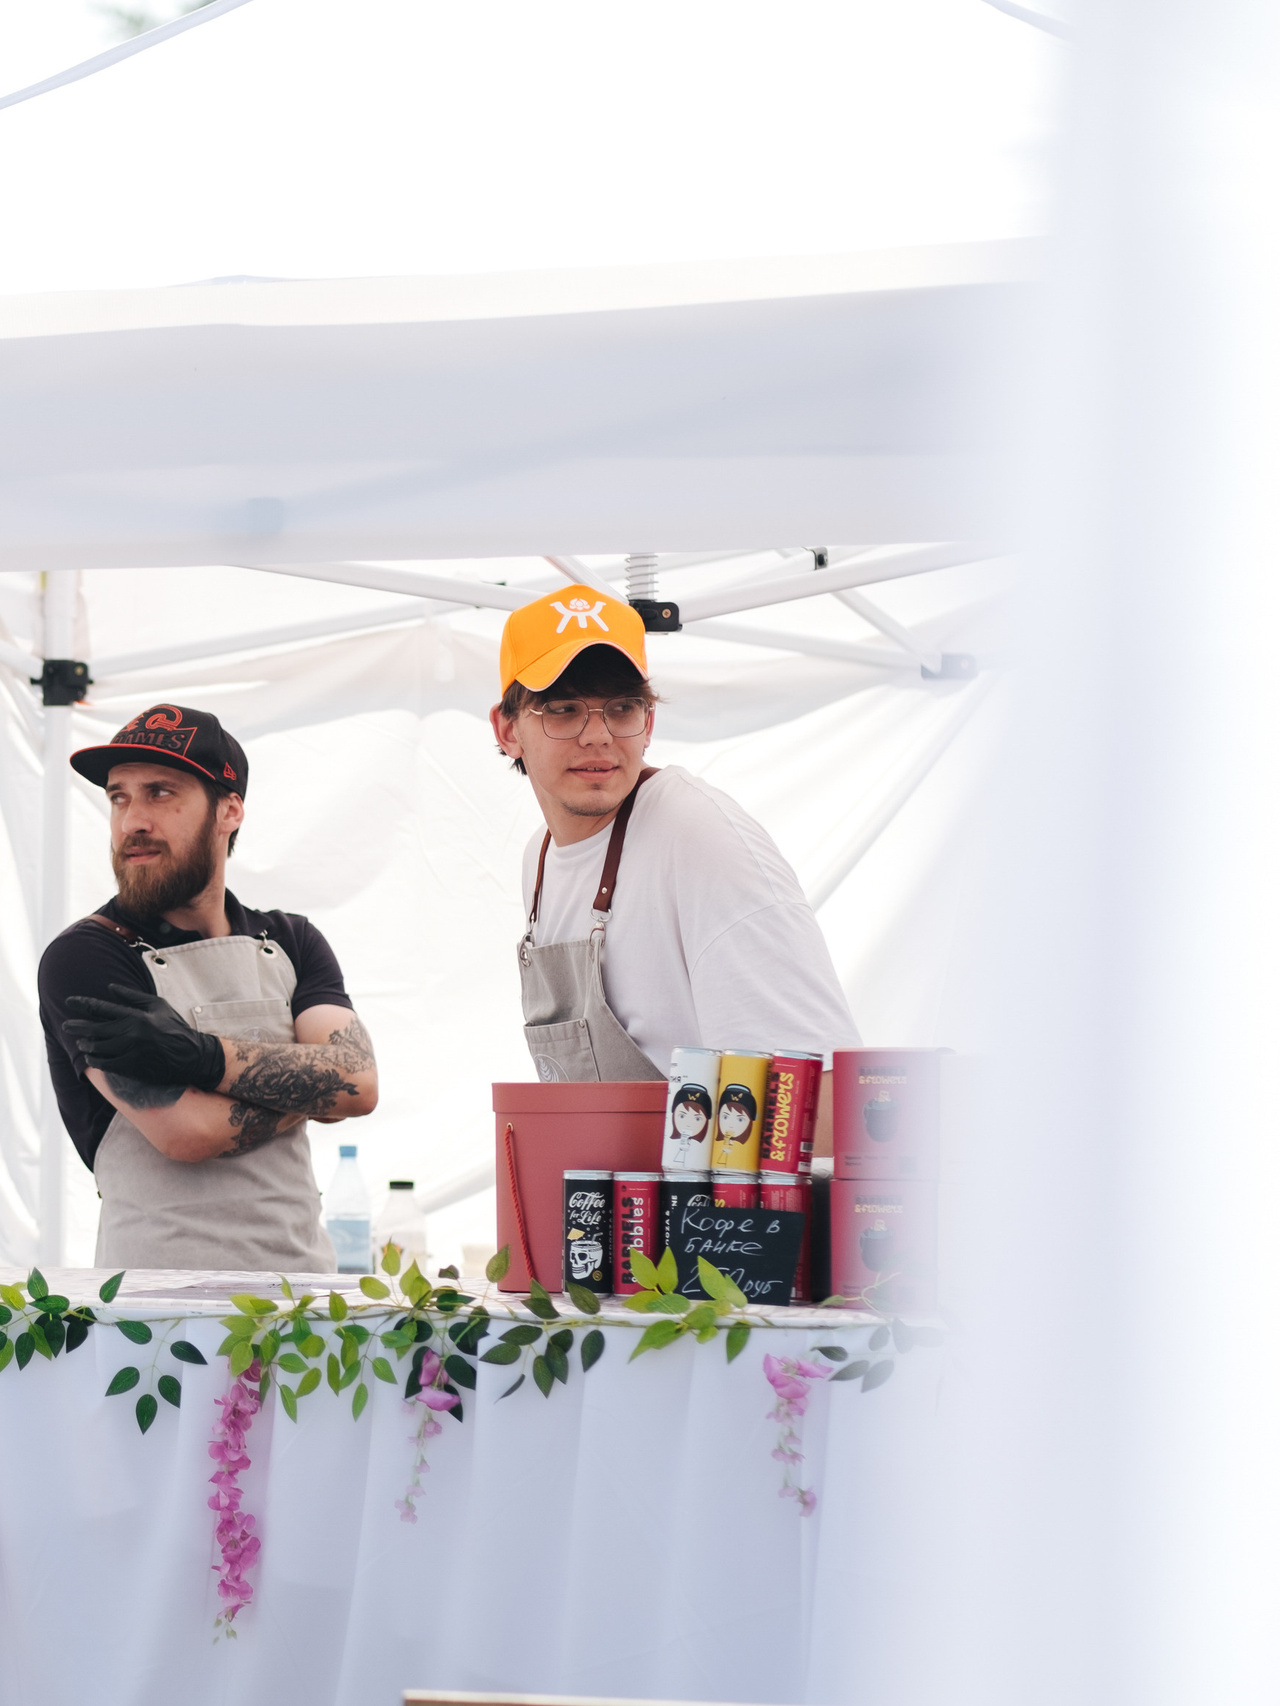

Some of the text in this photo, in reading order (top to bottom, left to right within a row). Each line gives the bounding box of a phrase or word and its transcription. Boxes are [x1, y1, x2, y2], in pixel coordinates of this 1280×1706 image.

[569, 1191, 606, 1210] Coffee
[569, 1210, 602, 1226] for Life
